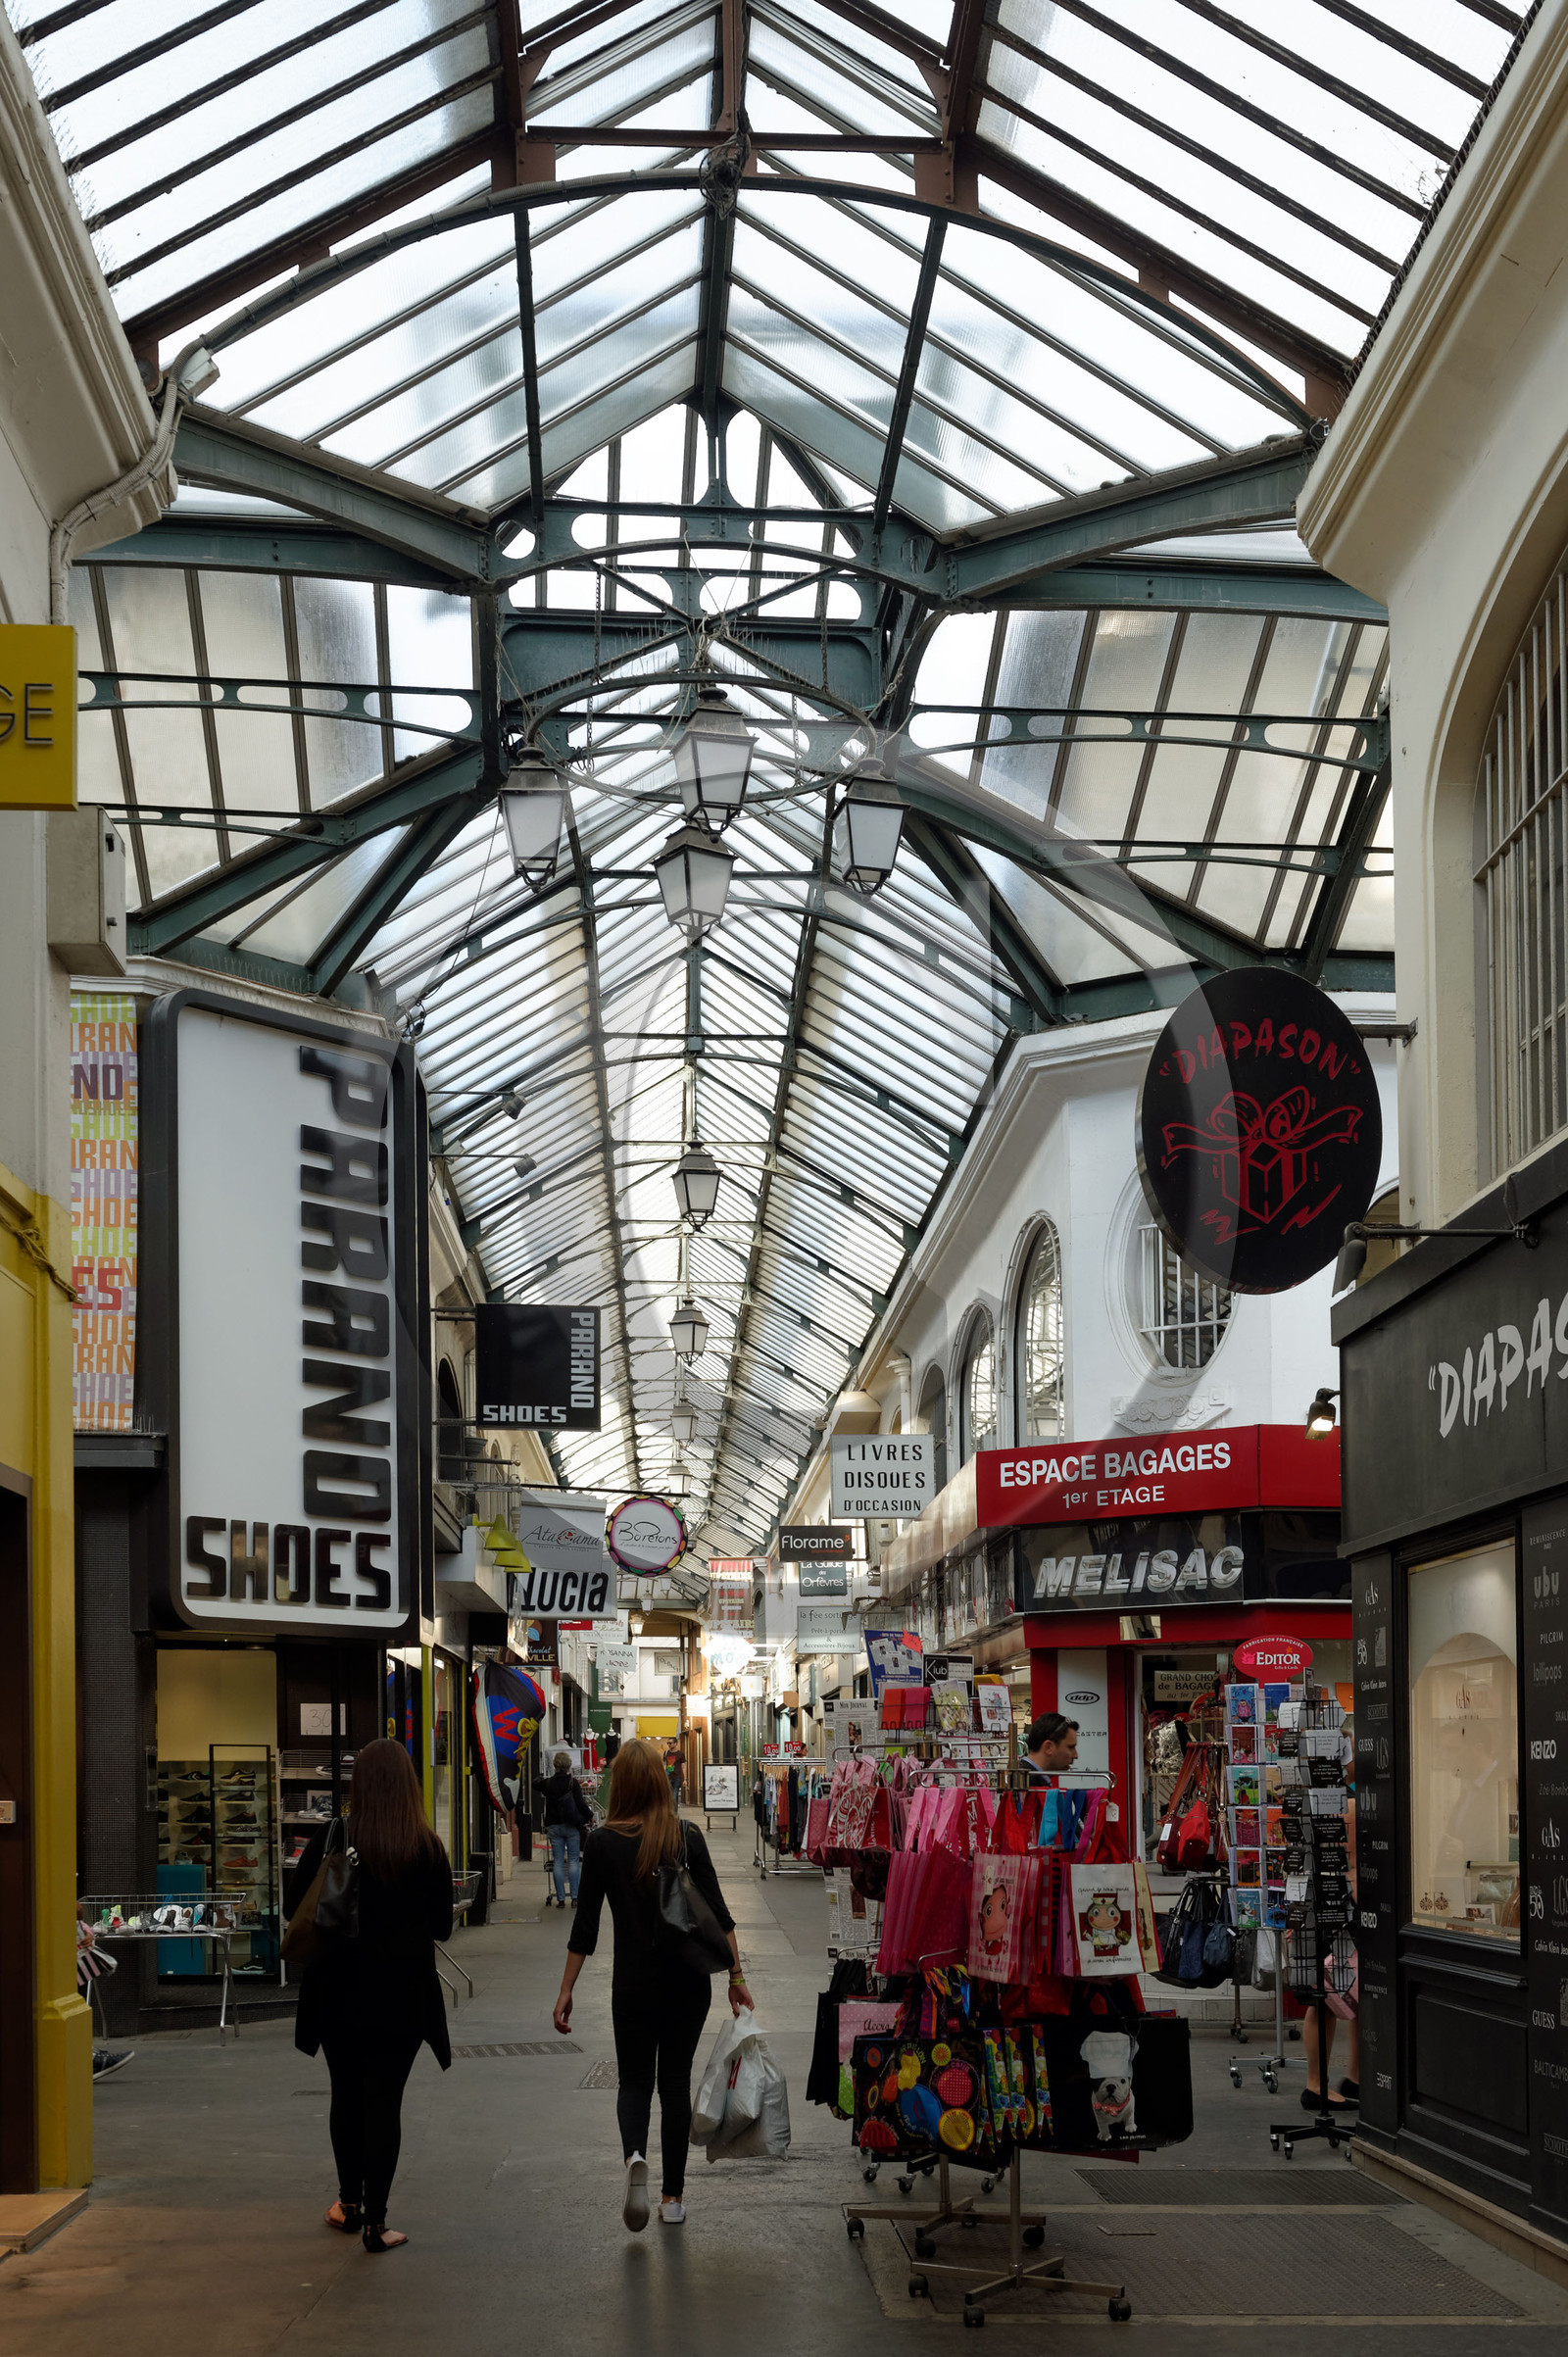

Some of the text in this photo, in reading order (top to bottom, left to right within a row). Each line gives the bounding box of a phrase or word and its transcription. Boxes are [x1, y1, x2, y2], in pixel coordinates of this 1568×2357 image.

[299, 1045, 391, 1521] PARANO
[570, 1311, 595, 1408] PARANO
[483, 1404, 567, 1424] SHOES
[847, 1444, 923, 1461] LIVRES
[1000, 1442, 1231, 1488] ESPACE BAGAGES
[844, 1499, 921, 1512] D'OCCASION
[1062, 1485, 1165, 1509] 1er ETAGE
[781, 1535, 844, 1549] Florame
[187, 1514, 391, 1609] SHOES
[802, 1577, 844, 1587] Orfèvres
[1534, 1565, 1559, 1598] ubu
[1534, 1597, 1560, 1610] PARIS
[1243, 1637, 1304, 1650] FABRICATION FRANÇAISE
[1540, 1631, 1564, 1645] PILGRIM
[1160, 1673, 1214, 1682] GRAND CHO
[1533, 1661, 1562, 1686] lollipops
[1358, 1738, 1373, 1752] GUESS
[1530, 1740, 1557, 1760] KENZO
[1360, 1786, 1377, 1812] ubu
[1542, 1817, 1561, 1847] GAS
[1534, 1939, 1548, 1952] Calvin
[1548, 1940, 1559, 1954] Klein
[1532, 2009, 1555, 2030] GUESS
